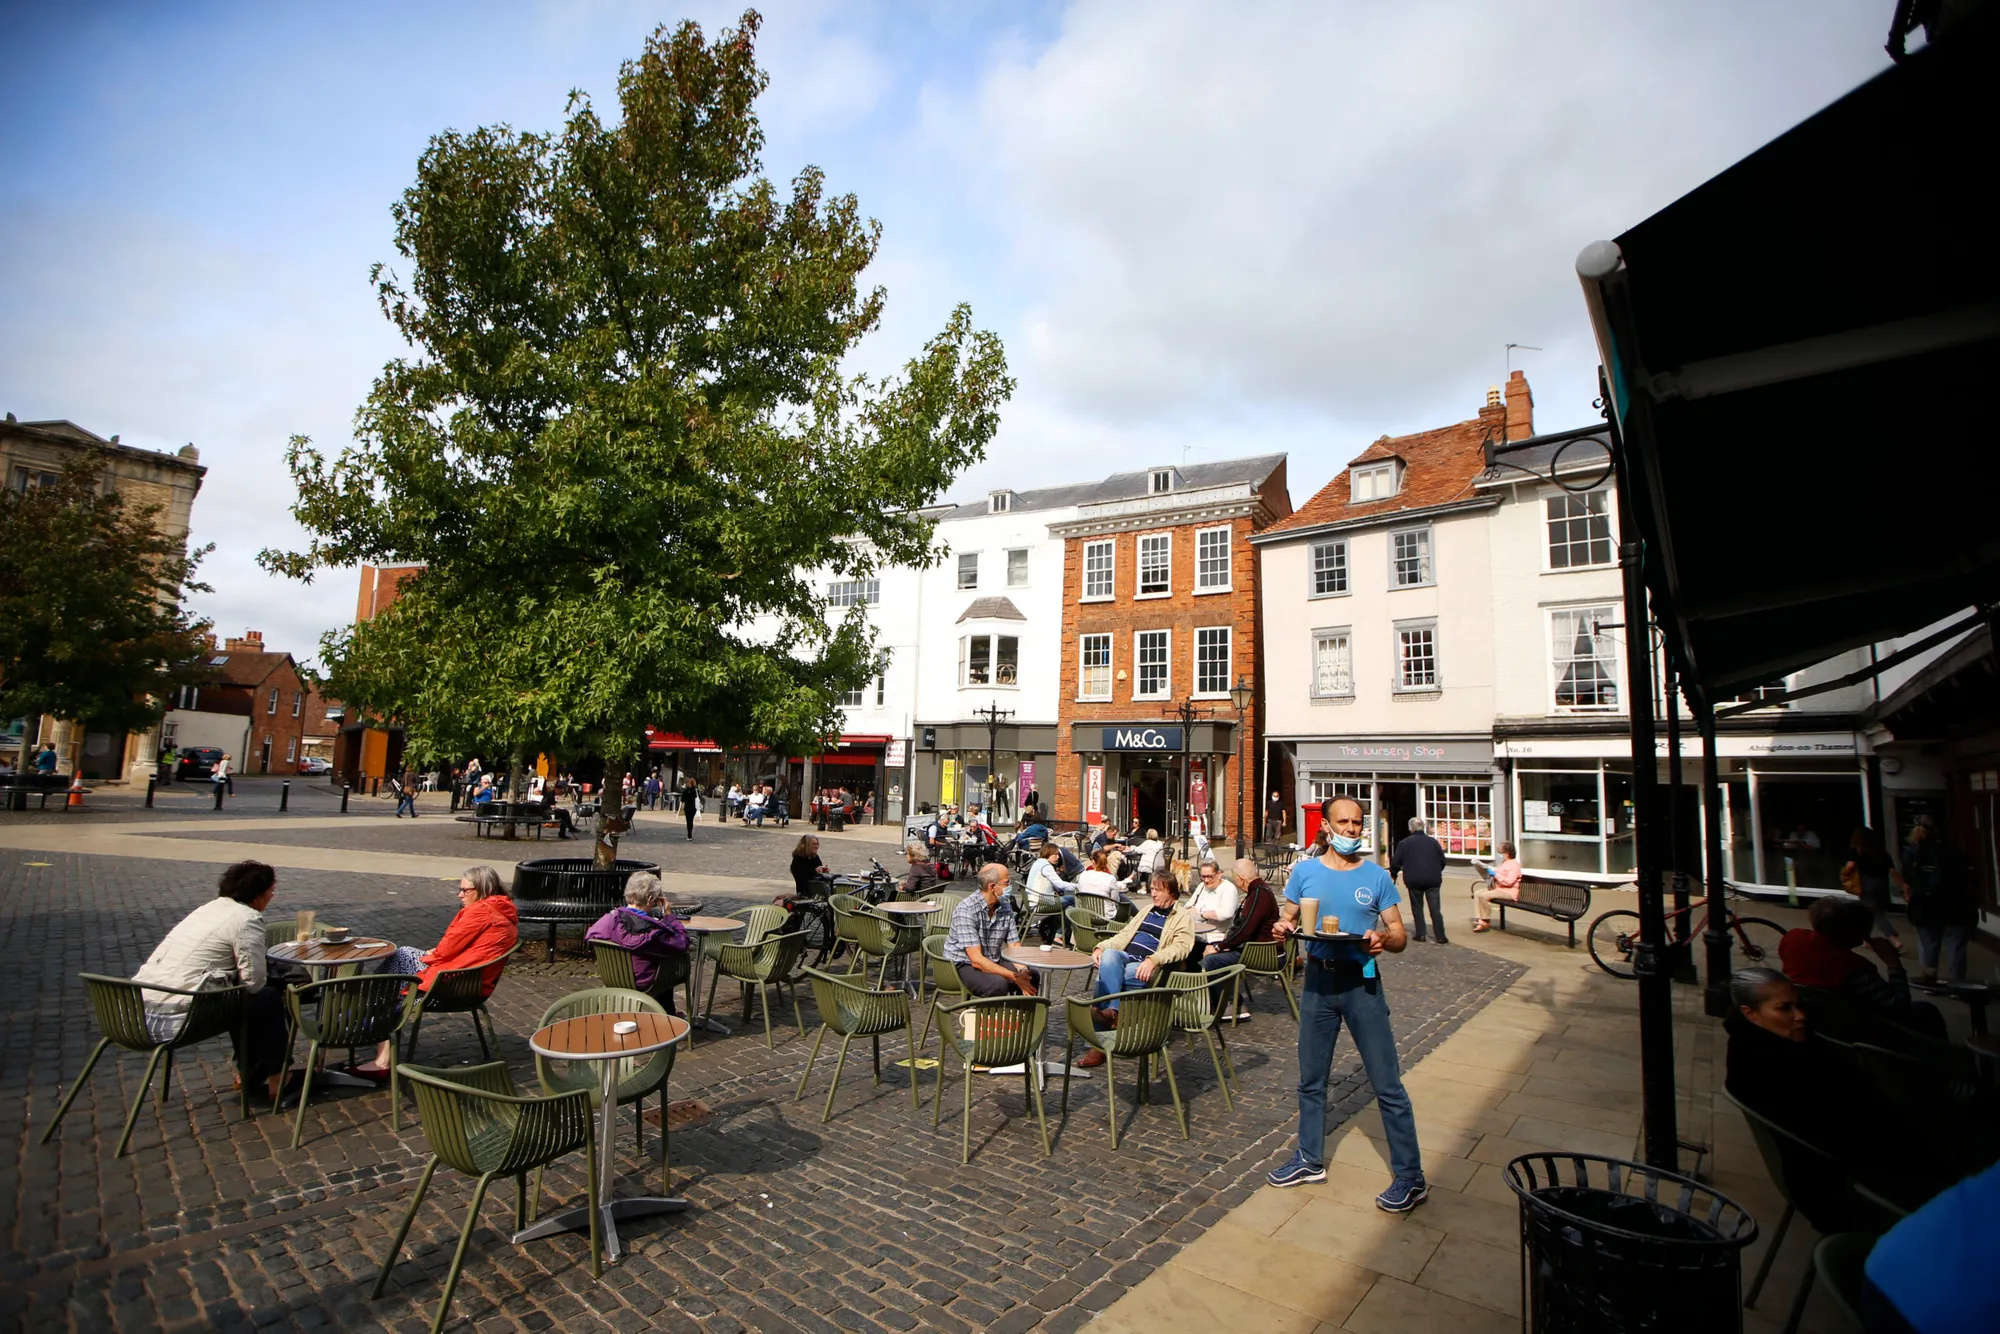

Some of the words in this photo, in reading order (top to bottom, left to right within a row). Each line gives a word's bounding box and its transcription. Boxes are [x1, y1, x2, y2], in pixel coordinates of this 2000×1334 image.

[1115, 729, 1167, 748] M&Co.
[1339, 746, 1359, 756] The
[1363, 746, 1410, 760] Nursery
[1413, 746, 1444, 760] Shop
[1748, 744, 1856, 753] Abingdon-on-Thames
[1091, 771, 1099, 810] SALE
